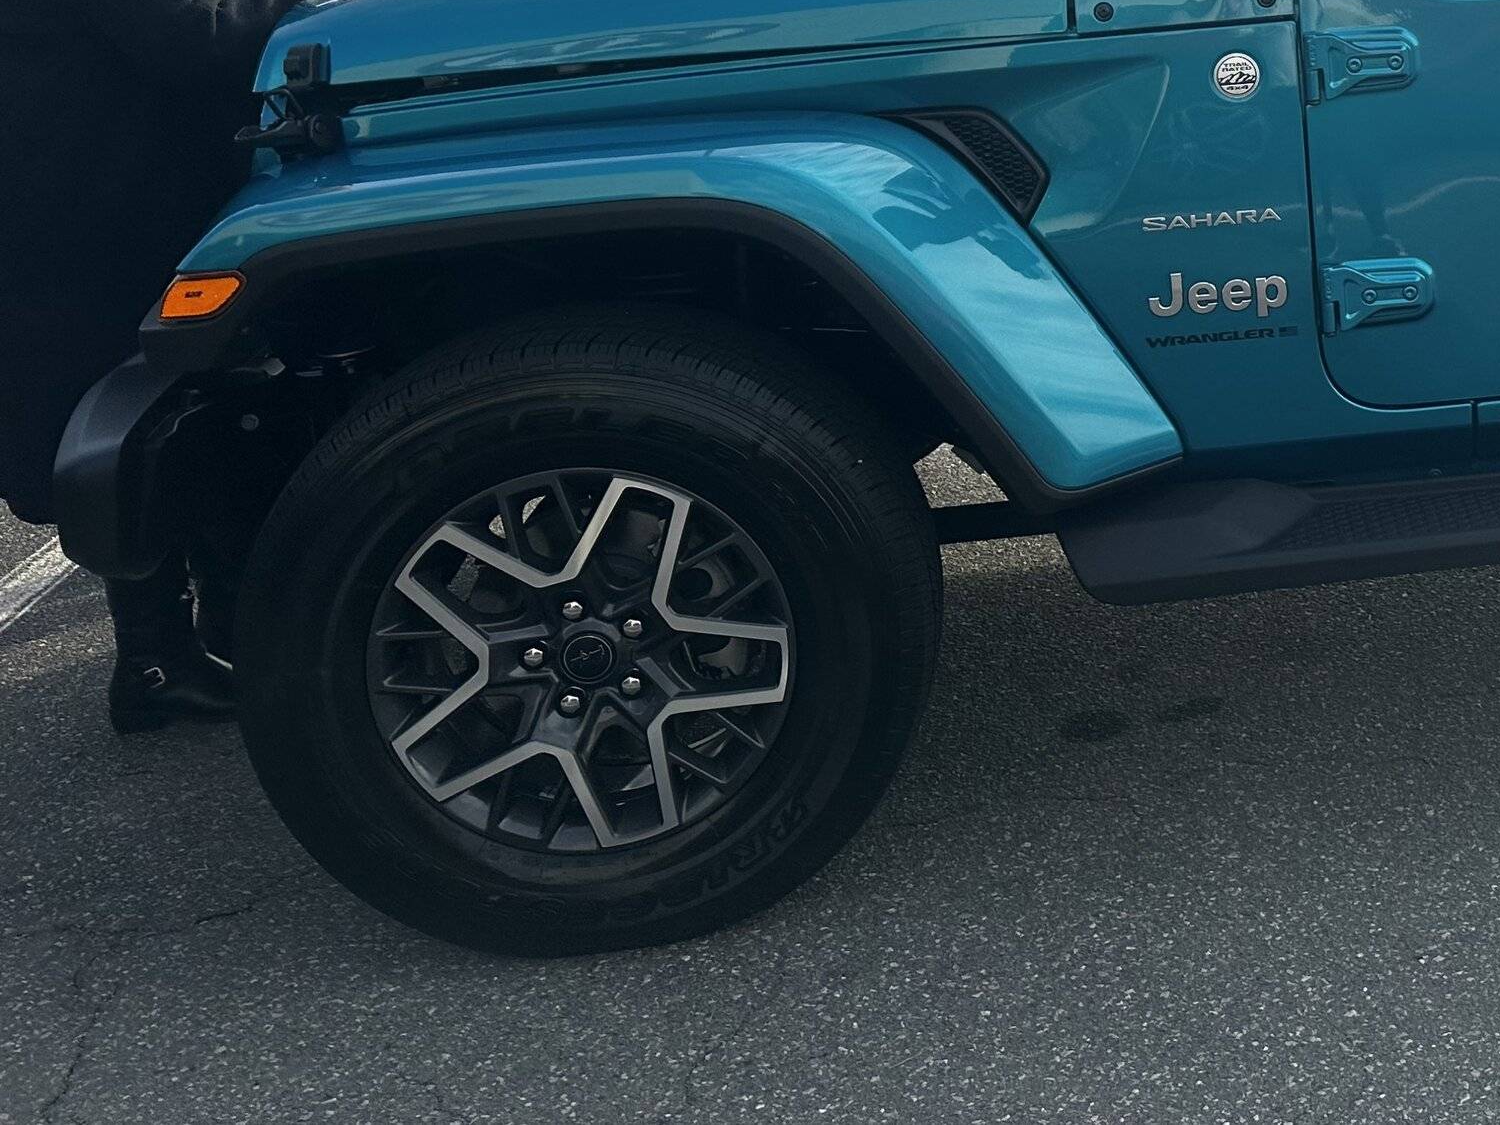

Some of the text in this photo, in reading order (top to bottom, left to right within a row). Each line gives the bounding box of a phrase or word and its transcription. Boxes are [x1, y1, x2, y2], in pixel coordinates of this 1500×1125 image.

[1142, 207, 1282, 232] SAHARA
[1148, 272, 1288, 317] Jeep
[1145, 327, 1275, 348] WRANGLER
